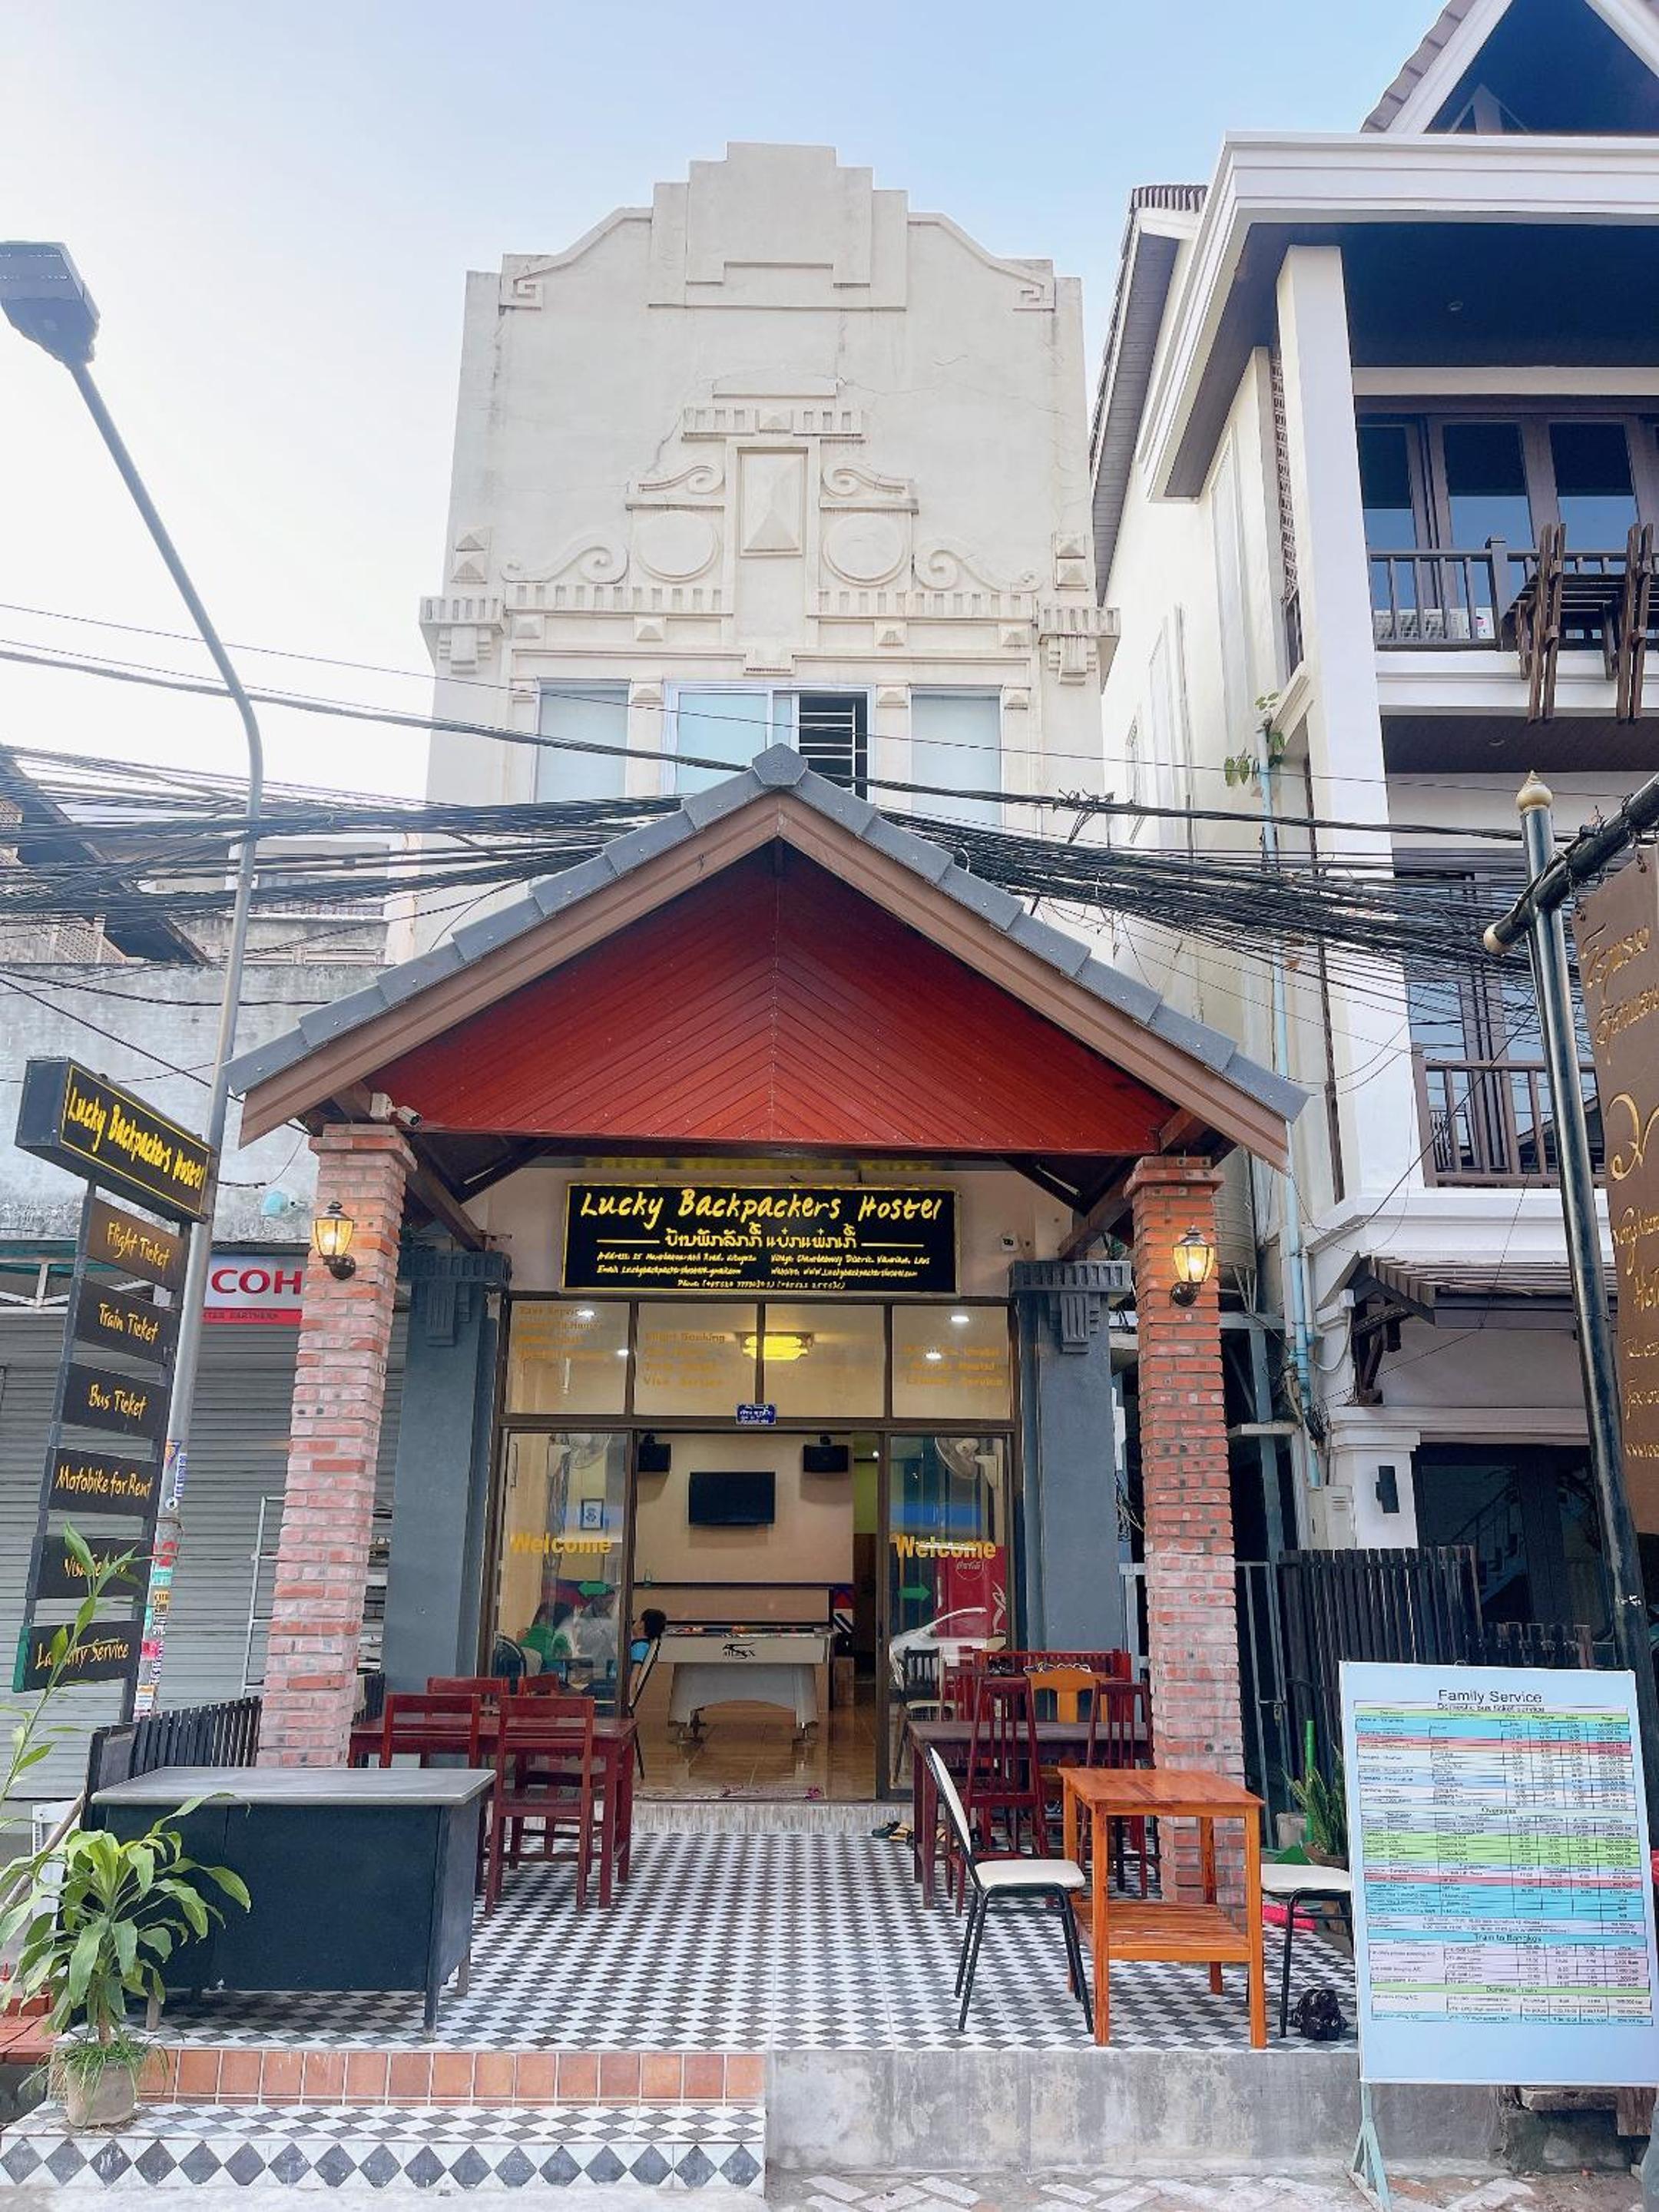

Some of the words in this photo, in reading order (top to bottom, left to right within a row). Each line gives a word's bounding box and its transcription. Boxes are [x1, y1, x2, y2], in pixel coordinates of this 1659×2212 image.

[67, 1087, 106, 1153] Lucky
[108, 1104, 172, 1173] Backpackers
[172, 1149, 206, 1191] Hostel
[581, 1192, 664, 1230] Lucky
[677, 1188, 840, 1223] Backpackers
[858, 1194, 942, 1222] Hostel
[106, 1222, 138, 1260] Flight
[139, 1237, 172, 1270] Ticket
[98, 1303, 124, 1333] Train
[127, 1313, 160, 1345] Ticket
[88, 1384, 111, 1412] Bus
[114, 1389, 148, 1419] Ticket
[56, 1464, 110, 1494] Motobike
[111, 1470, 127, 1495] for
[128, 1472, 153, 1501] Rent
[510, 1532, 613, 1555] Welcome
[895, 1534, 997, 1559] Welcome
[90, 1637, 129, 1663] Service
[1438, 1689, 1486, 1704] Family
[1489, 1690, 1542, 1704] Service
